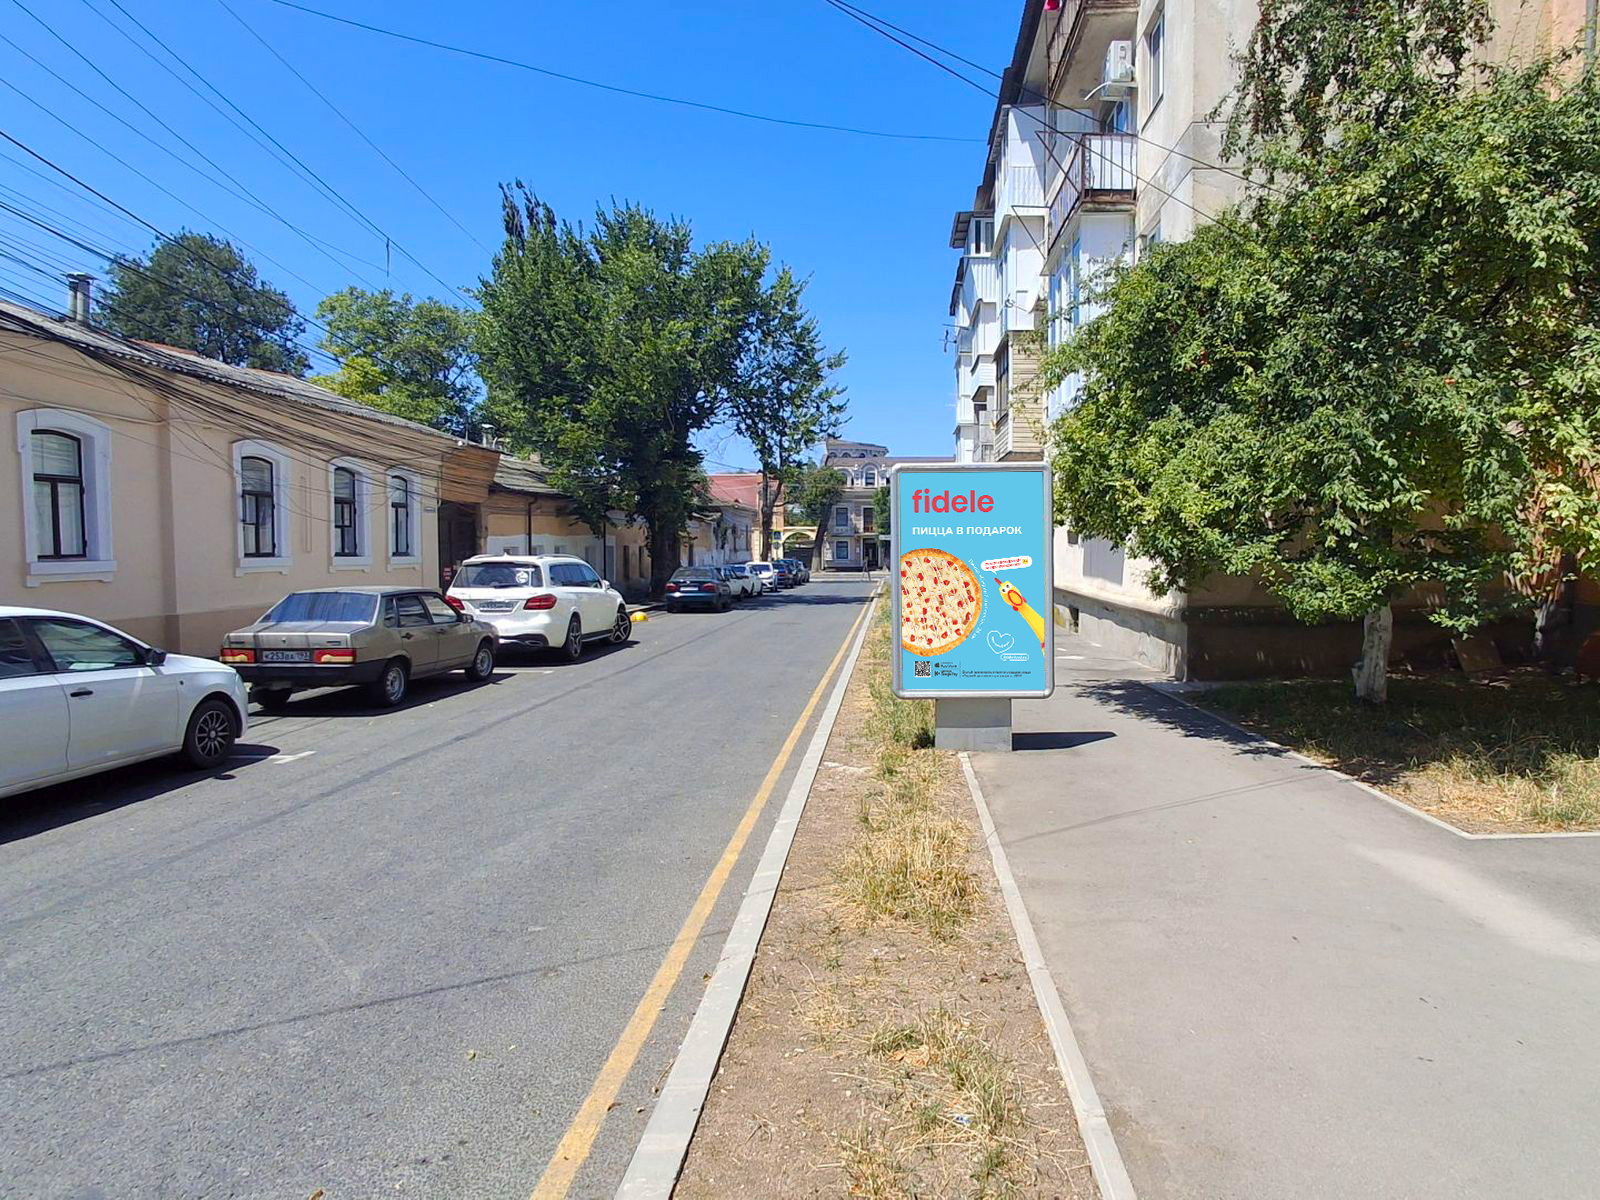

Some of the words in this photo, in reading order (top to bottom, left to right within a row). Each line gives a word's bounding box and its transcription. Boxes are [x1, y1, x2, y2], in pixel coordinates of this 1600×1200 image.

[912, 488, 994, 513] fidele
[912, 526, 953, 537] ПИЦЦА
[956, 526, 964, 535] В
[966, 526, 1022, 537] ПОДАРОК
